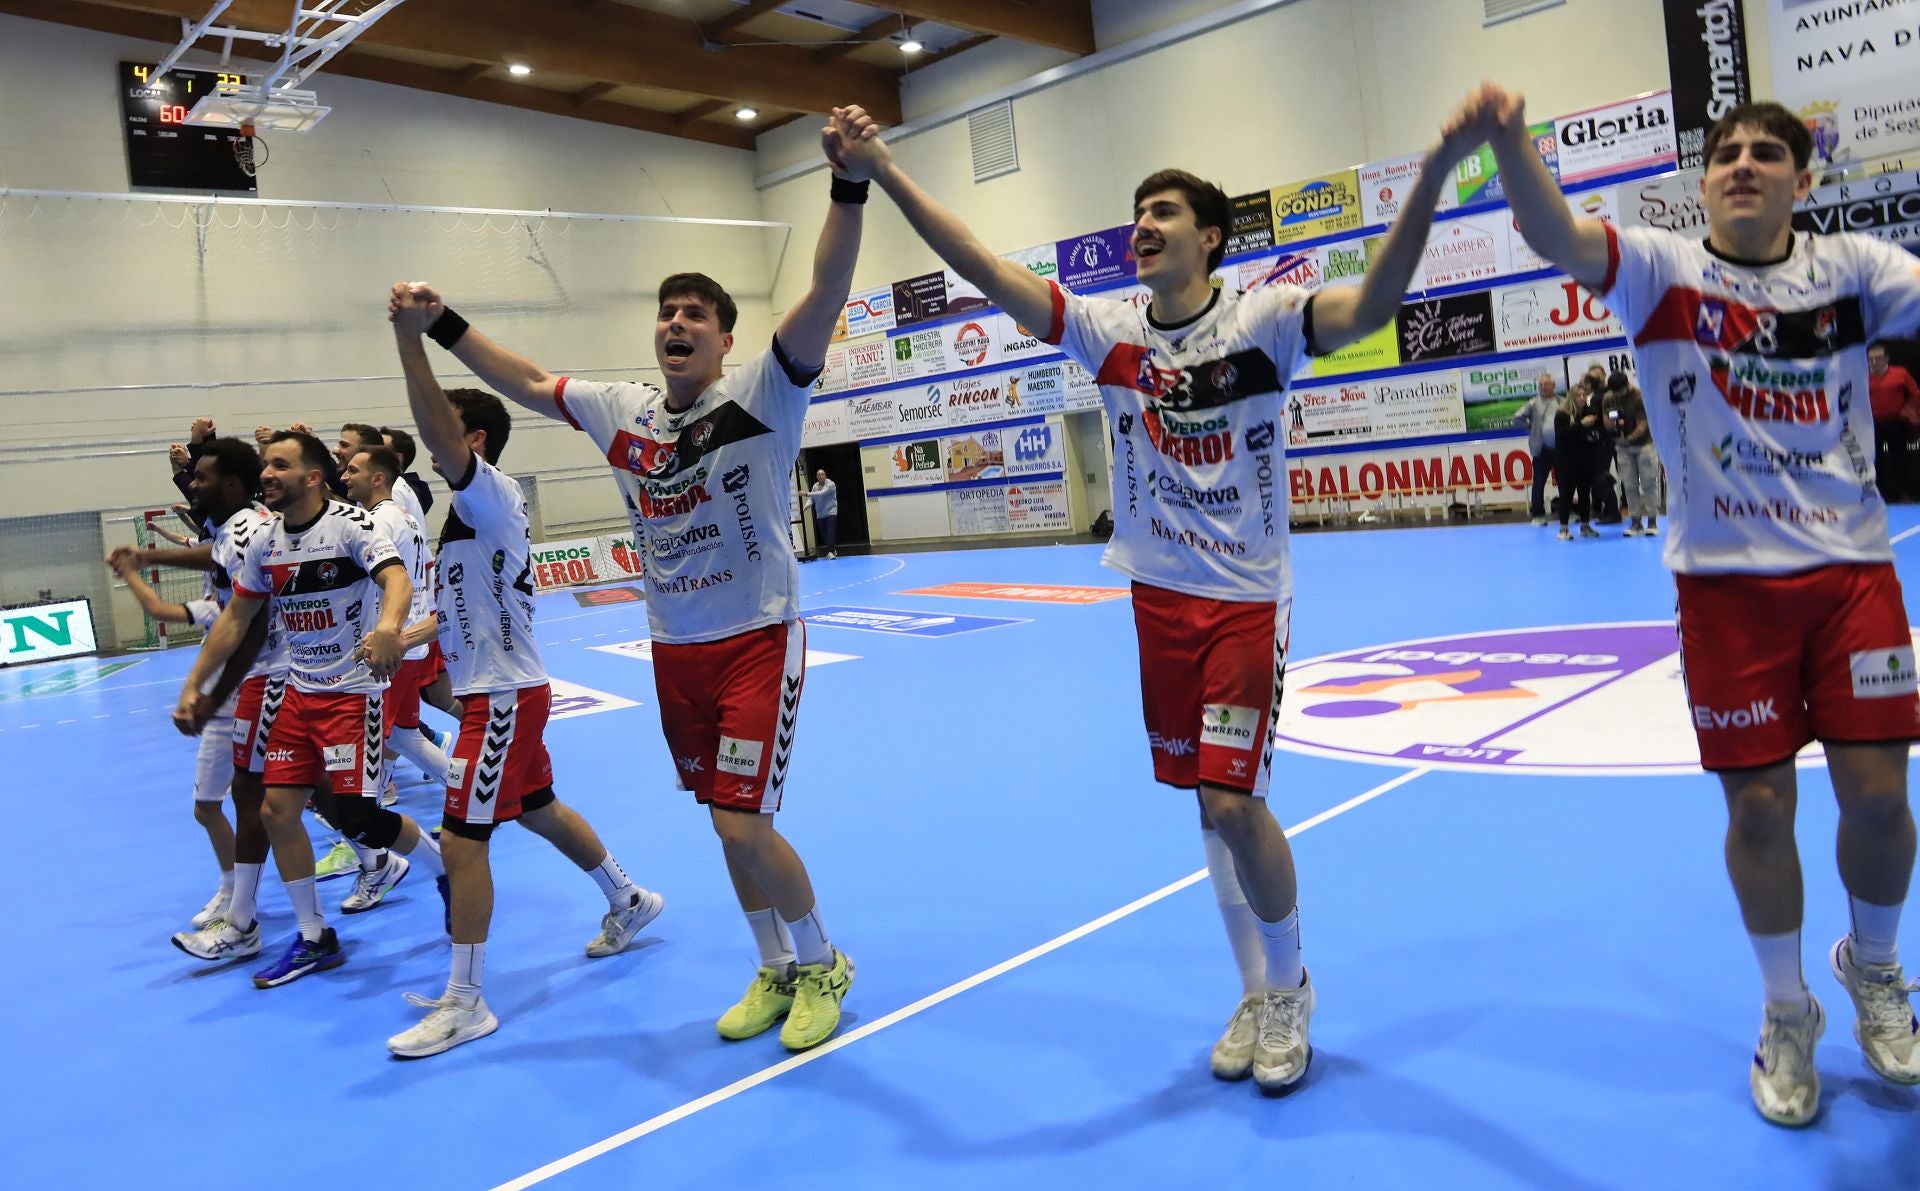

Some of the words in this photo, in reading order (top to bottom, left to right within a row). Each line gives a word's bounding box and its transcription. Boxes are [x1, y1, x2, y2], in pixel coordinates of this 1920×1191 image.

[1797, 39, 1876, 72] NAVA
[1894, 26, 1920, 47] D
[1561, 105, 1669, 147] Gloria
[1855, 125, 1878, 142] de
[1275, 192, 1345, 219] CONDE
[1756, 312, 1778, 354] 8
[952, 380, 982, 392] Viajes
[1027, 366, 1061, 380] HUMBERTO
[1027, 379, 1055, 392] MAESTRO
[1469, 367, 1519, 385] Borja
[948, 387, 1000, 407] RINCON
[898, 404, 943, 422] Semorsec
[1289, 449, 1533, 505] BALONMANO
[959, 487, 1005, 501] ORTOPEDIA
[1255, 453, 1275, 538] POLISAC
[733, 492, 762, 563] POLISAC
[531, 546, 591, 564] VEROS
[287, 566, 301, 593] 7
[533, 558, 599, 588] EROL
[453, 587, 476, 651] POLISAC
